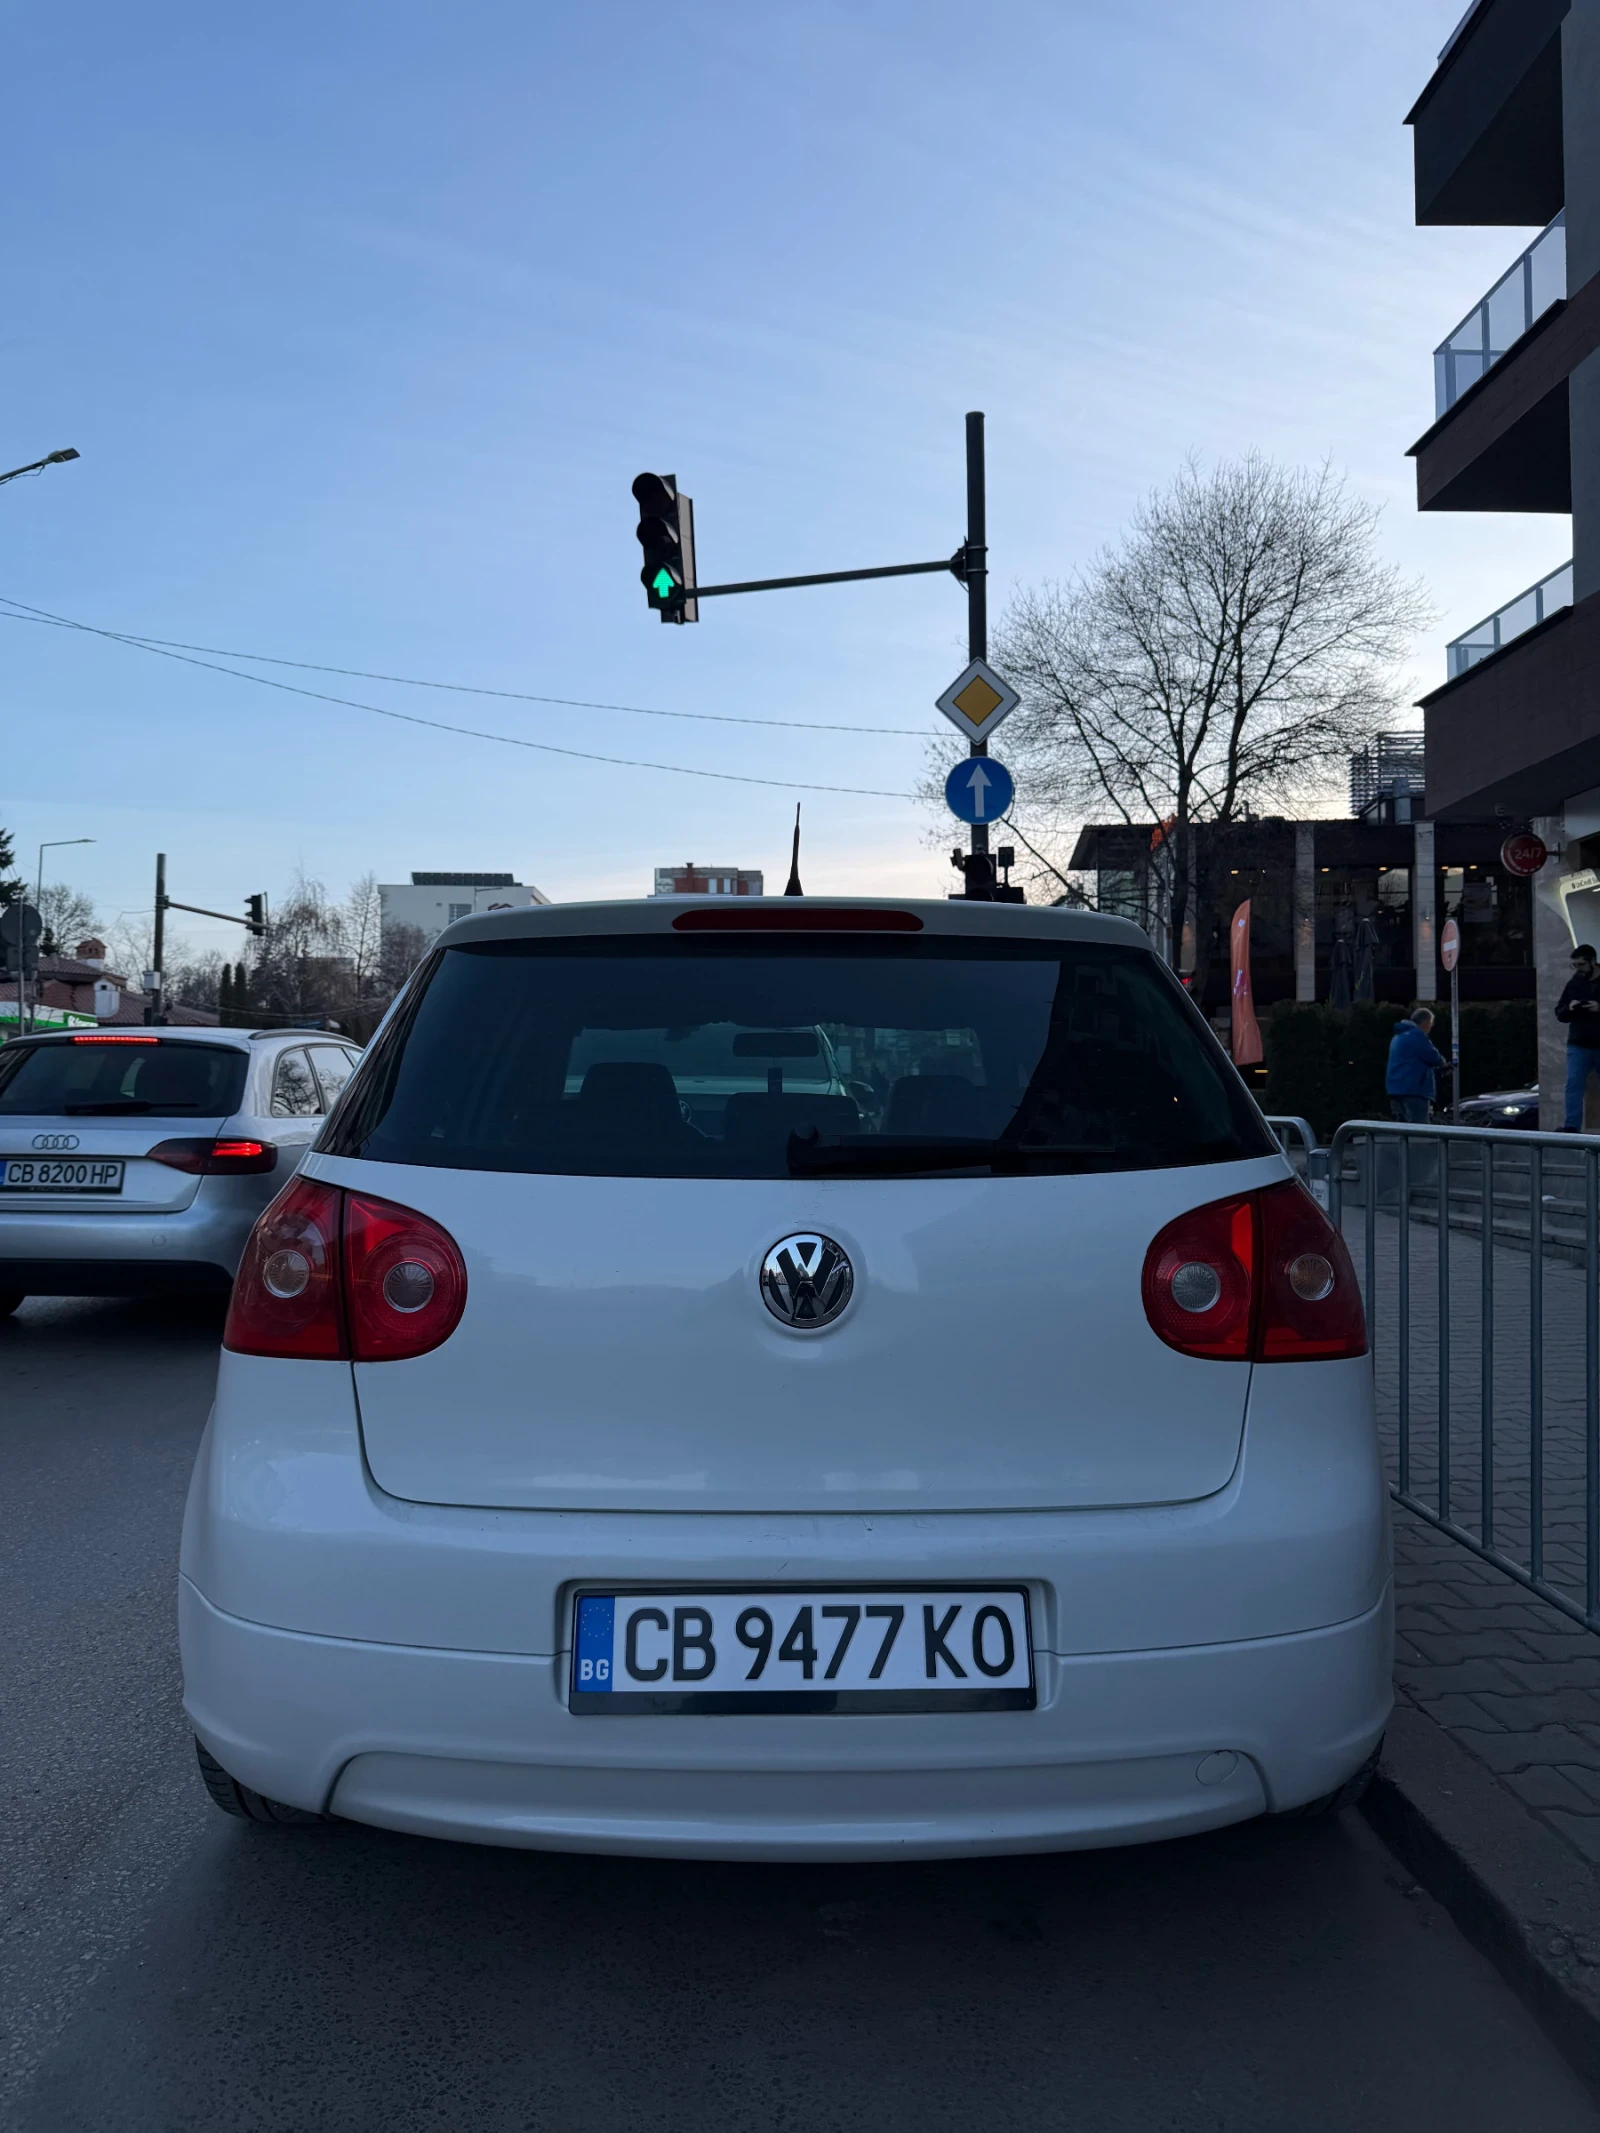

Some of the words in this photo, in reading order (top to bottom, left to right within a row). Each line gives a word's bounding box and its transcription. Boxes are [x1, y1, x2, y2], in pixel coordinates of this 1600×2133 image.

[1515, 847, 1542, 860] 24/7
[8, 1164, 34, 1183] CB
[38, 1164, 88, 1184] 8200
[90, 1165, 118, 1184] HP
[625, 1606, 717, 1682] CB
[735, 1605, 905, 1680] 9477
[923, 1605, 1015, 1679] KO
[580, 1658, 610, 1681] BG
